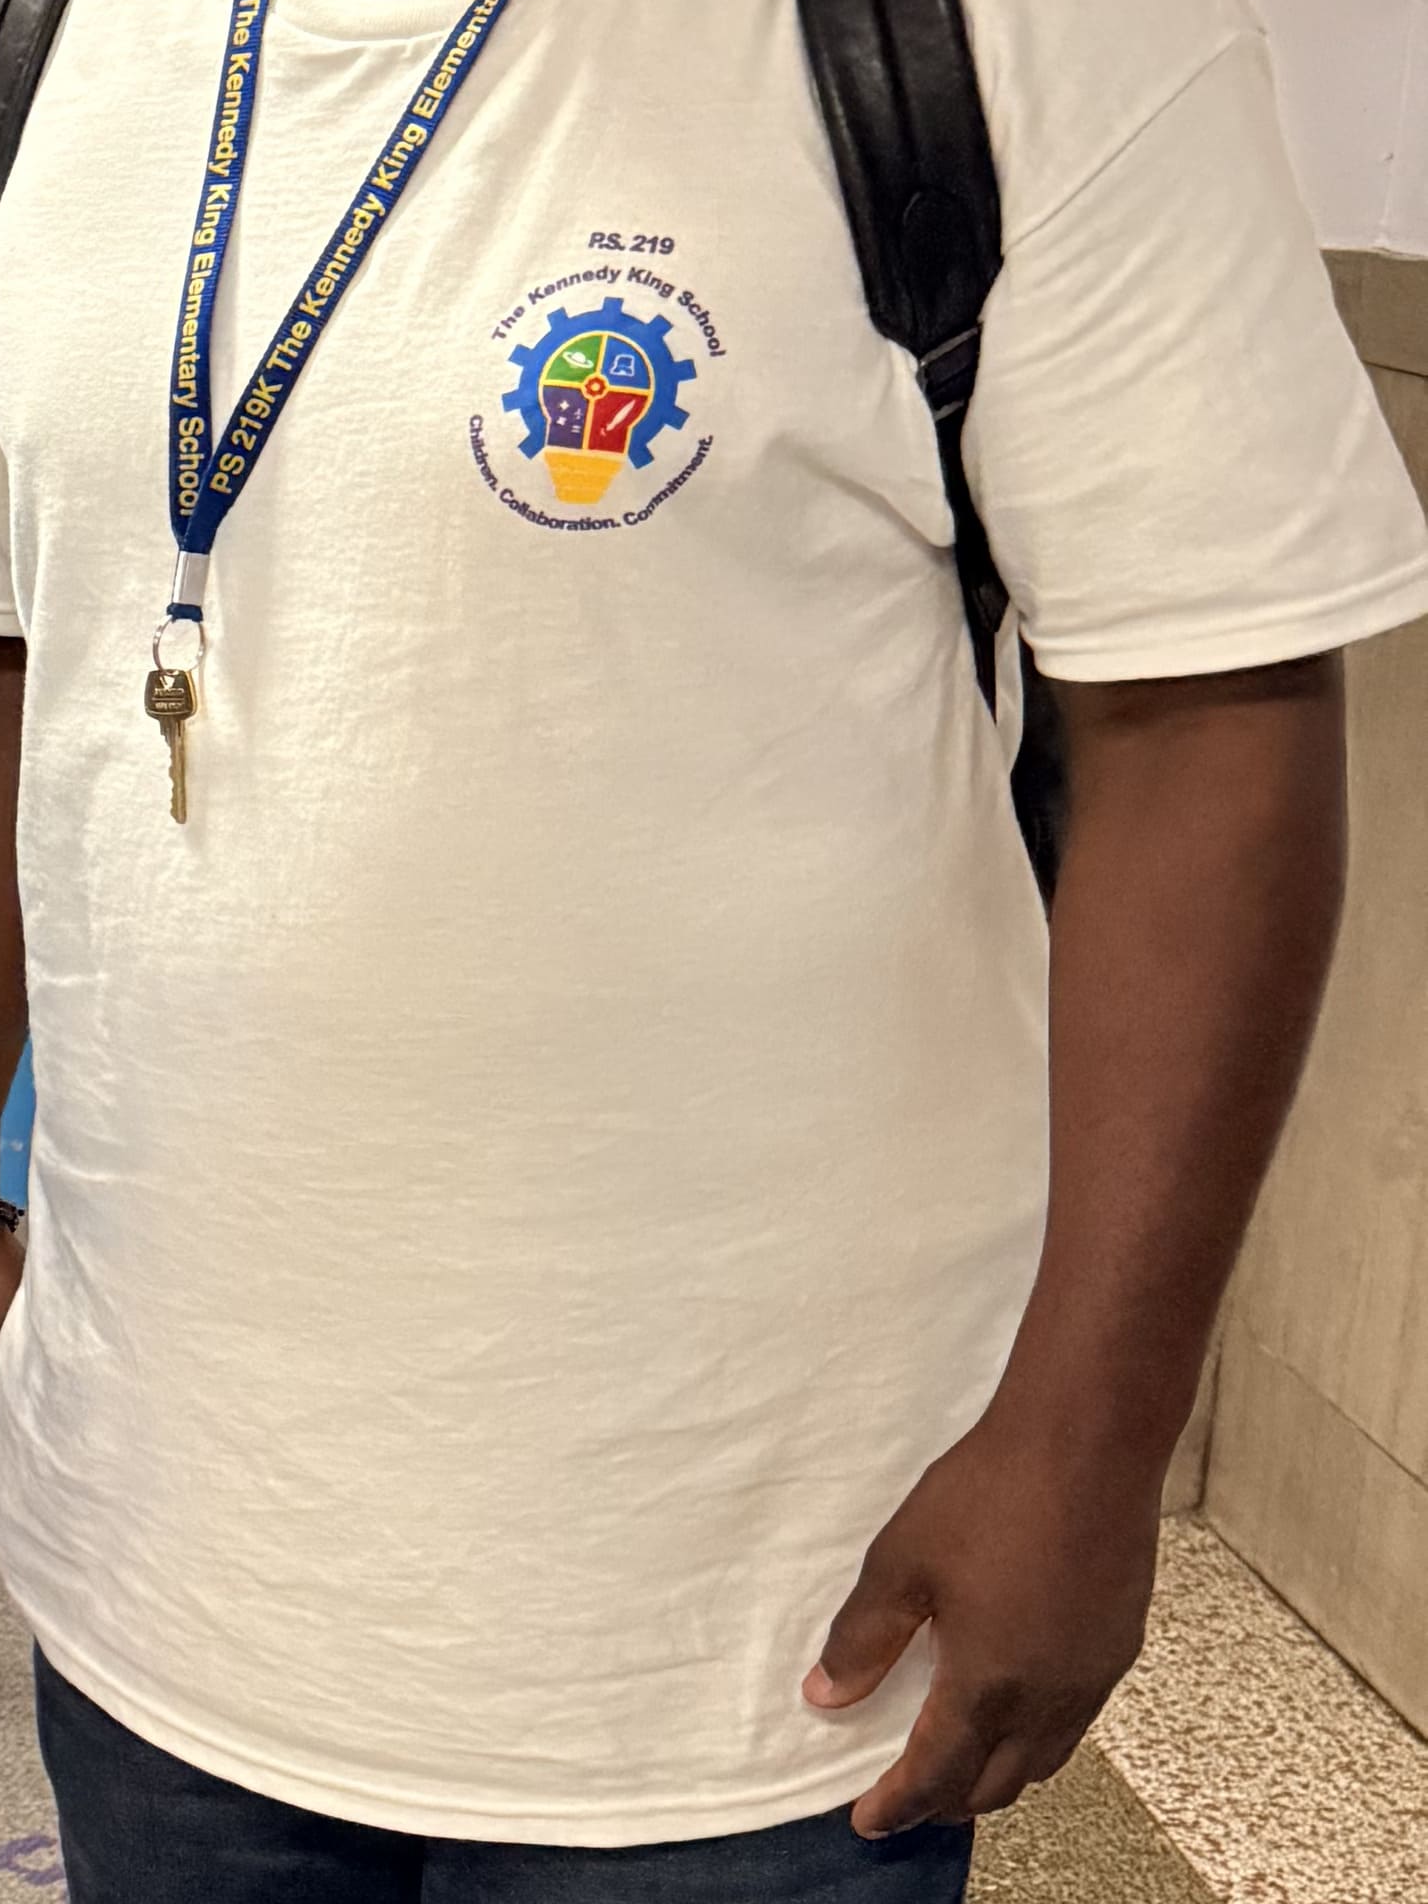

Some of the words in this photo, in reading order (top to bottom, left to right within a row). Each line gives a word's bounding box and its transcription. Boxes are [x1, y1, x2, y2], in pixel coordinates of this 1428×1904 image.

[207, 52, 253, 177] Kennedy
[194, 183, 233, 246] King
[629, 233, 675, 255] 219
[173, 250, 215, 409] Elementary
[210, 452, 246, 495] PS
[231, 374, 284, 451] 219K
[266, 321, 312, 371] The
[298, 192, 386, 317] Kennedy
[371, 123, 428, 191] King
[492, 304, 526, 342] The
[528, 265, 622, 305] Kennedy
[627, 266, 676, 299] King
[677, 290, 726, 358] School
[470, 414, 499, 493] Children.
[499, 487, 621, 532] Collaboration.
[622, 433, 715, 527] Commitment.
